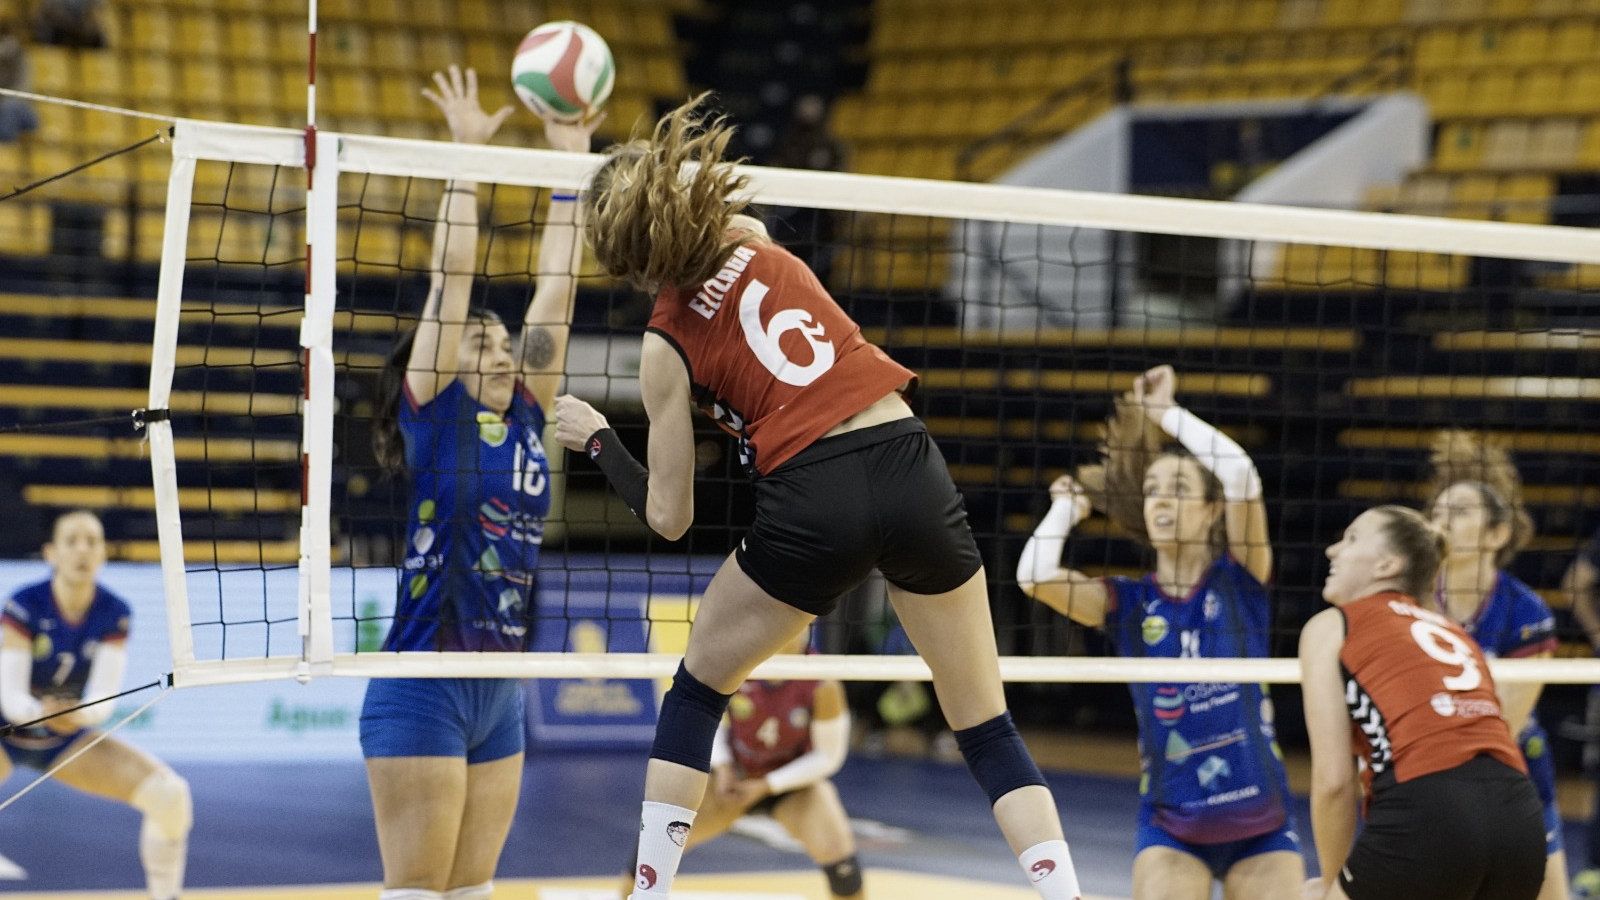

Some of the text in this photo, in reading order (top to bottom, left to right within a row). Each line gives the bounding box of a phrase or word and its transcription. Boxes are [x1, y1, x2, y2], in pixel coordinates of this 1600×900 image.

[738, 278, 836, 387] 6
[1410, 619, 1481, 691] 9
[755, 716, 779, 749] 4
